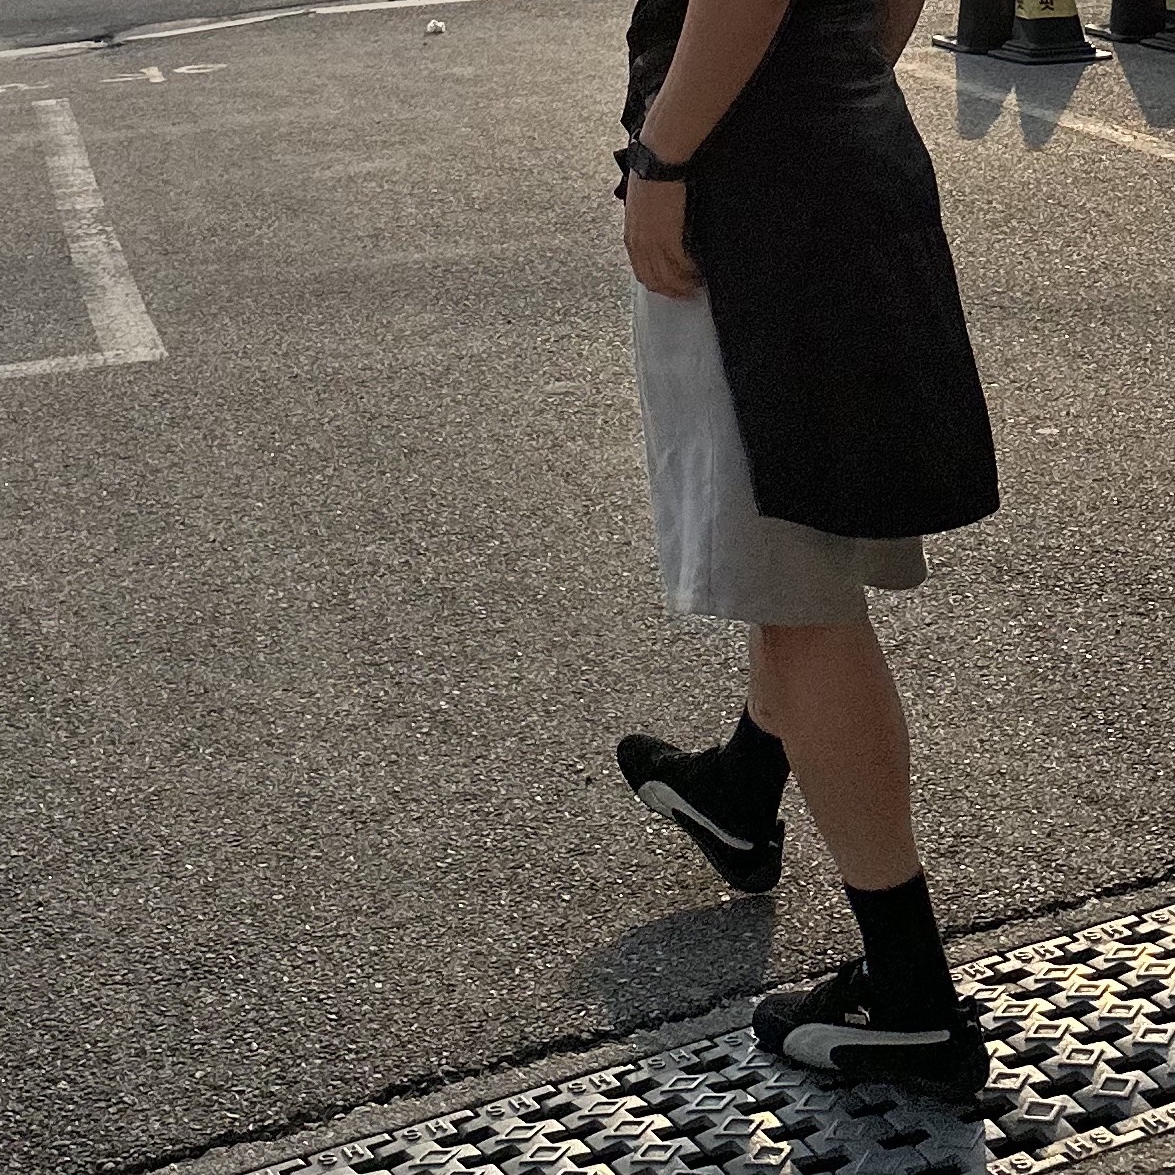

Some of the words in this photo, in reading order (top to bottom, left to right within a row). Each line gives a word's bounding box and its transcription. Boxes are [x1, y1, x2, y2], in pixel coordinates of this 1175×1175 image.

[318, 1143, 364, 1165] SH
[403, 1118, 447, 1141] SH
[486, 1094, 532, 1117] SH
[567, 1072, 613, 1094] SH
[647, 1049, 691, 1070] SH
[722, 1033, 743, 1047] S
[1013, 944, 1057, 962] SH
[1082, 923, 1124, 941] SH
